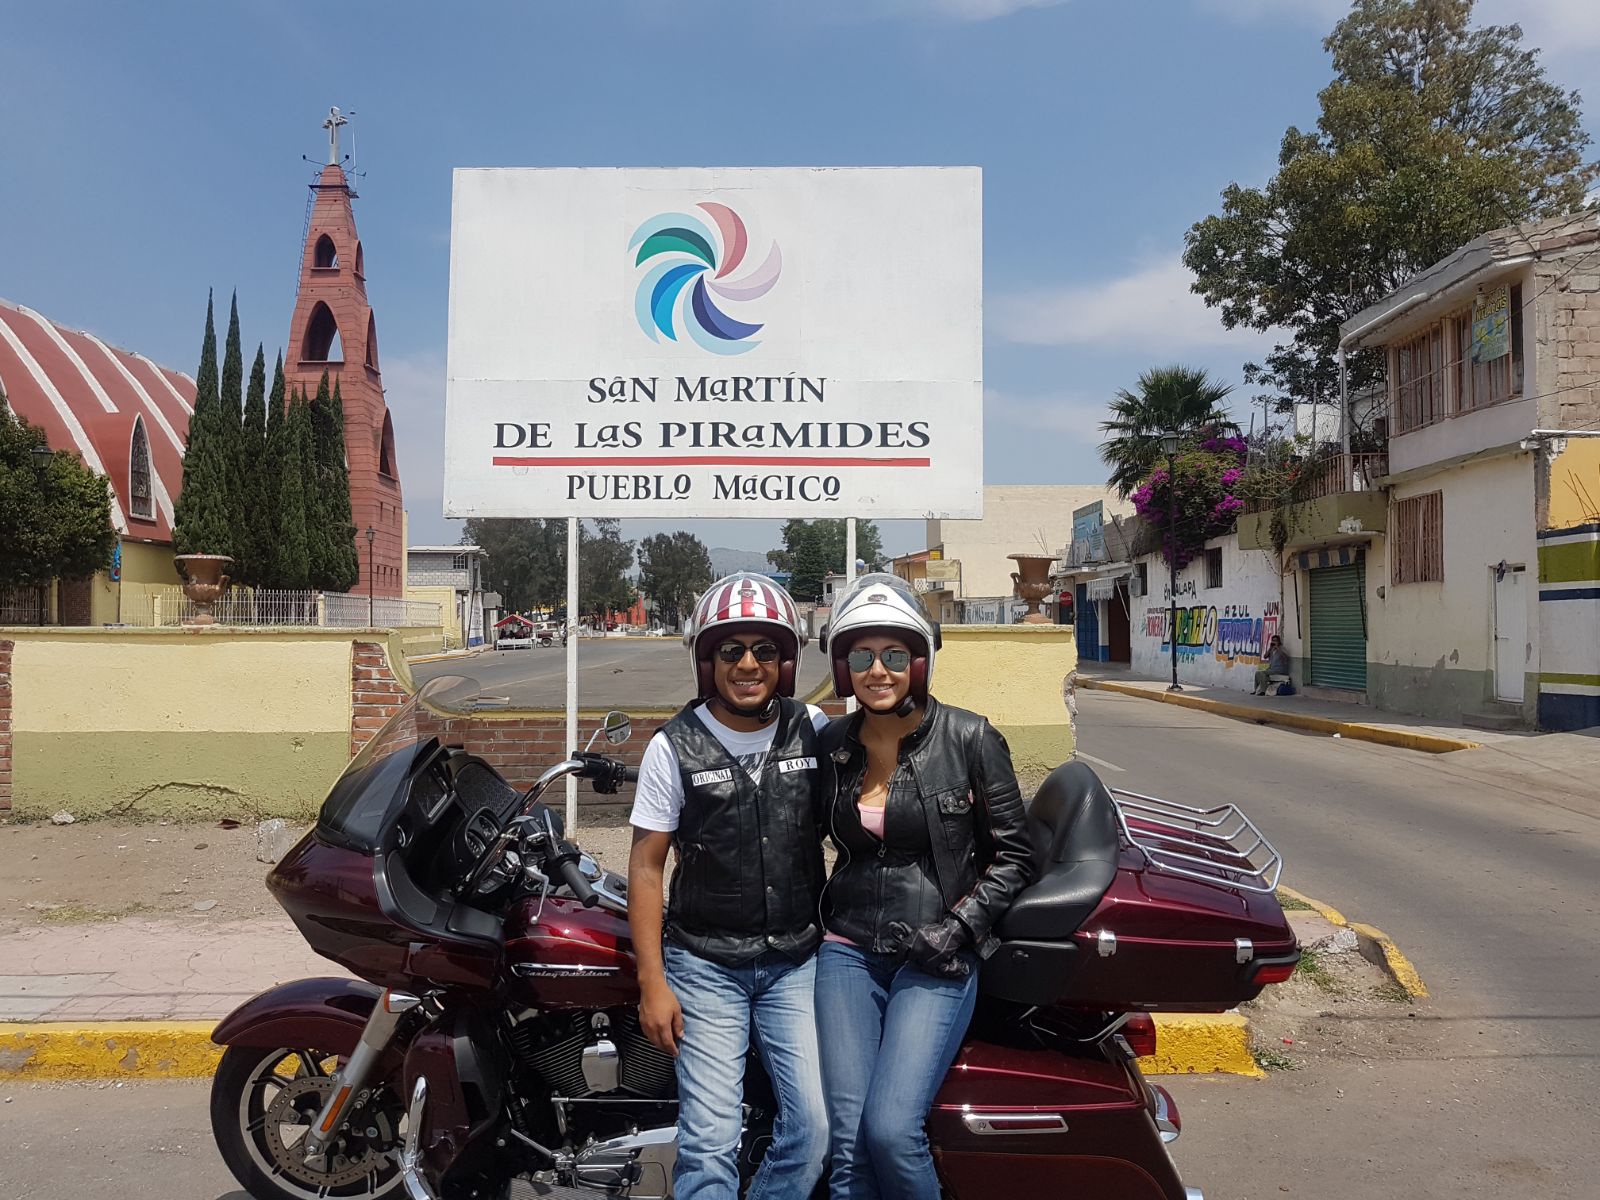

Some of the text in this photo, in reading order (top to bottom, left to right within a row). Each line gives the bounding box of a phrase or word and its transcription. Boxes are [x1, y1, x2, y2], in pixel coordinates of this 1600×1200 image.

[493, 422, 553, 449] DE
[1224, 604, 1250, 618] AZUL
[786, 757, 812, 771] ROY
[693, 769, 732, 785] ORIGINAL
